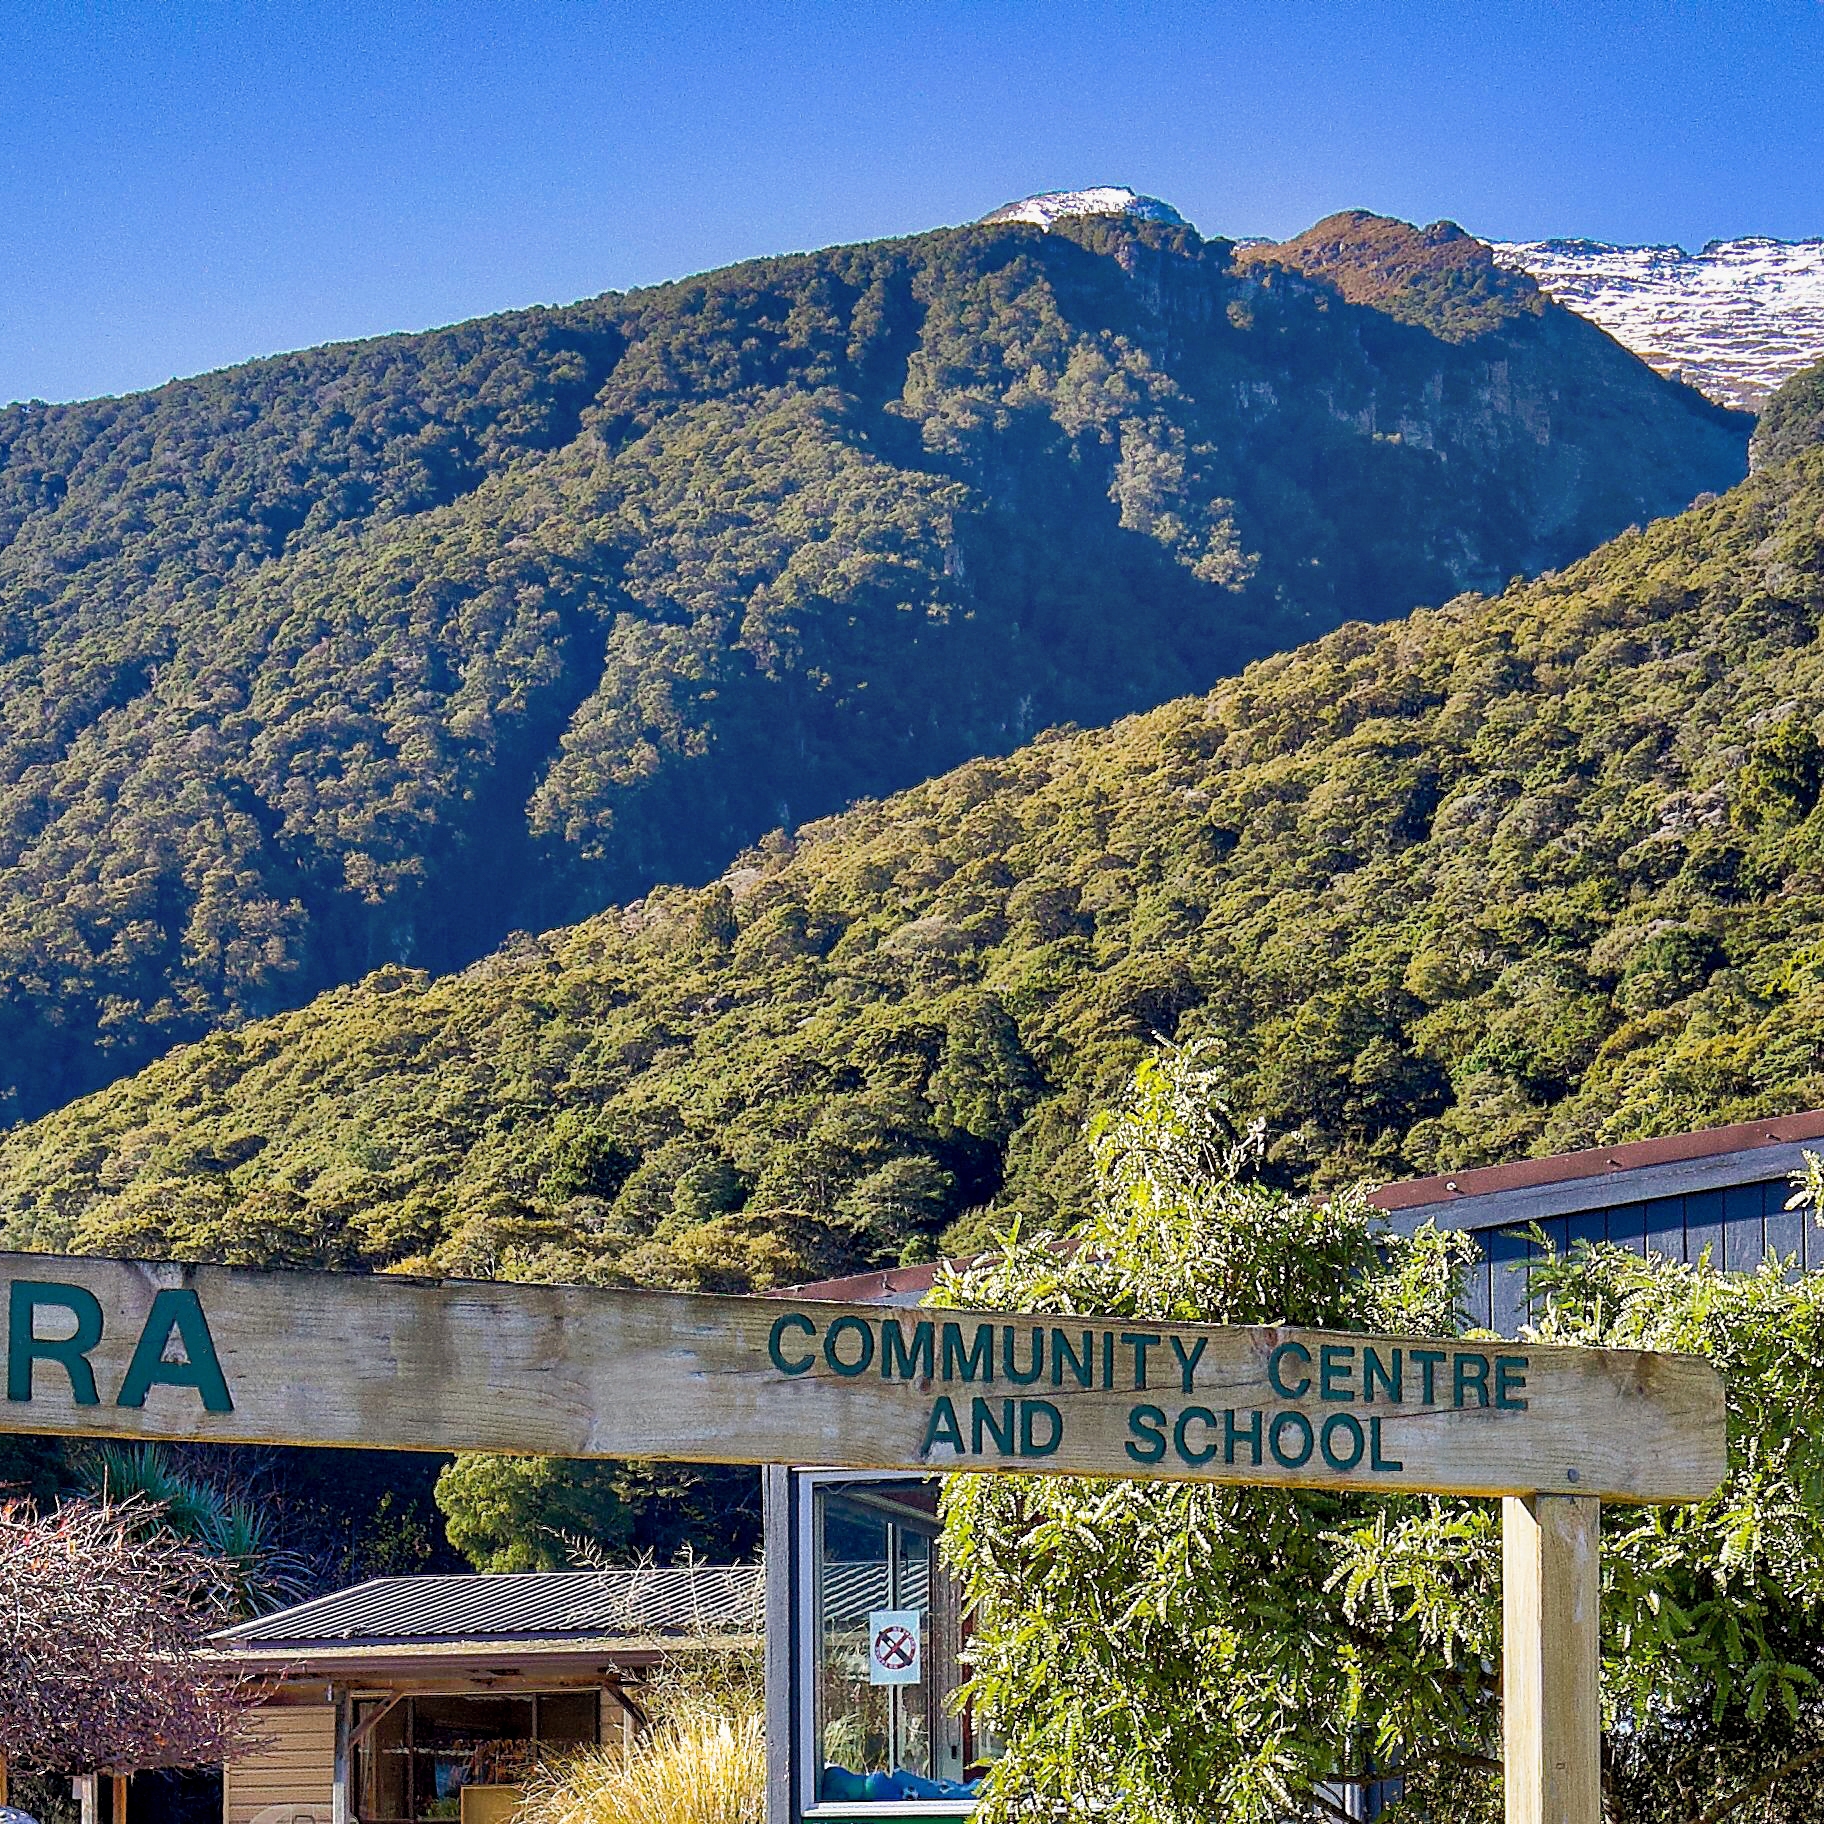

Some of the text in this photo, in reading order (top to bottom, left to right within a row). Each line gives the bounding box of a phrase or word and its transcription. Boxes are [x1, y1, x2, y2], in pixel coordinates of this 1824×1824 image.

[768, 1312, 1530, 1410] COMMUNITY CENTRE
[919, 1395, 1404, 1472] AND SCHOOL
